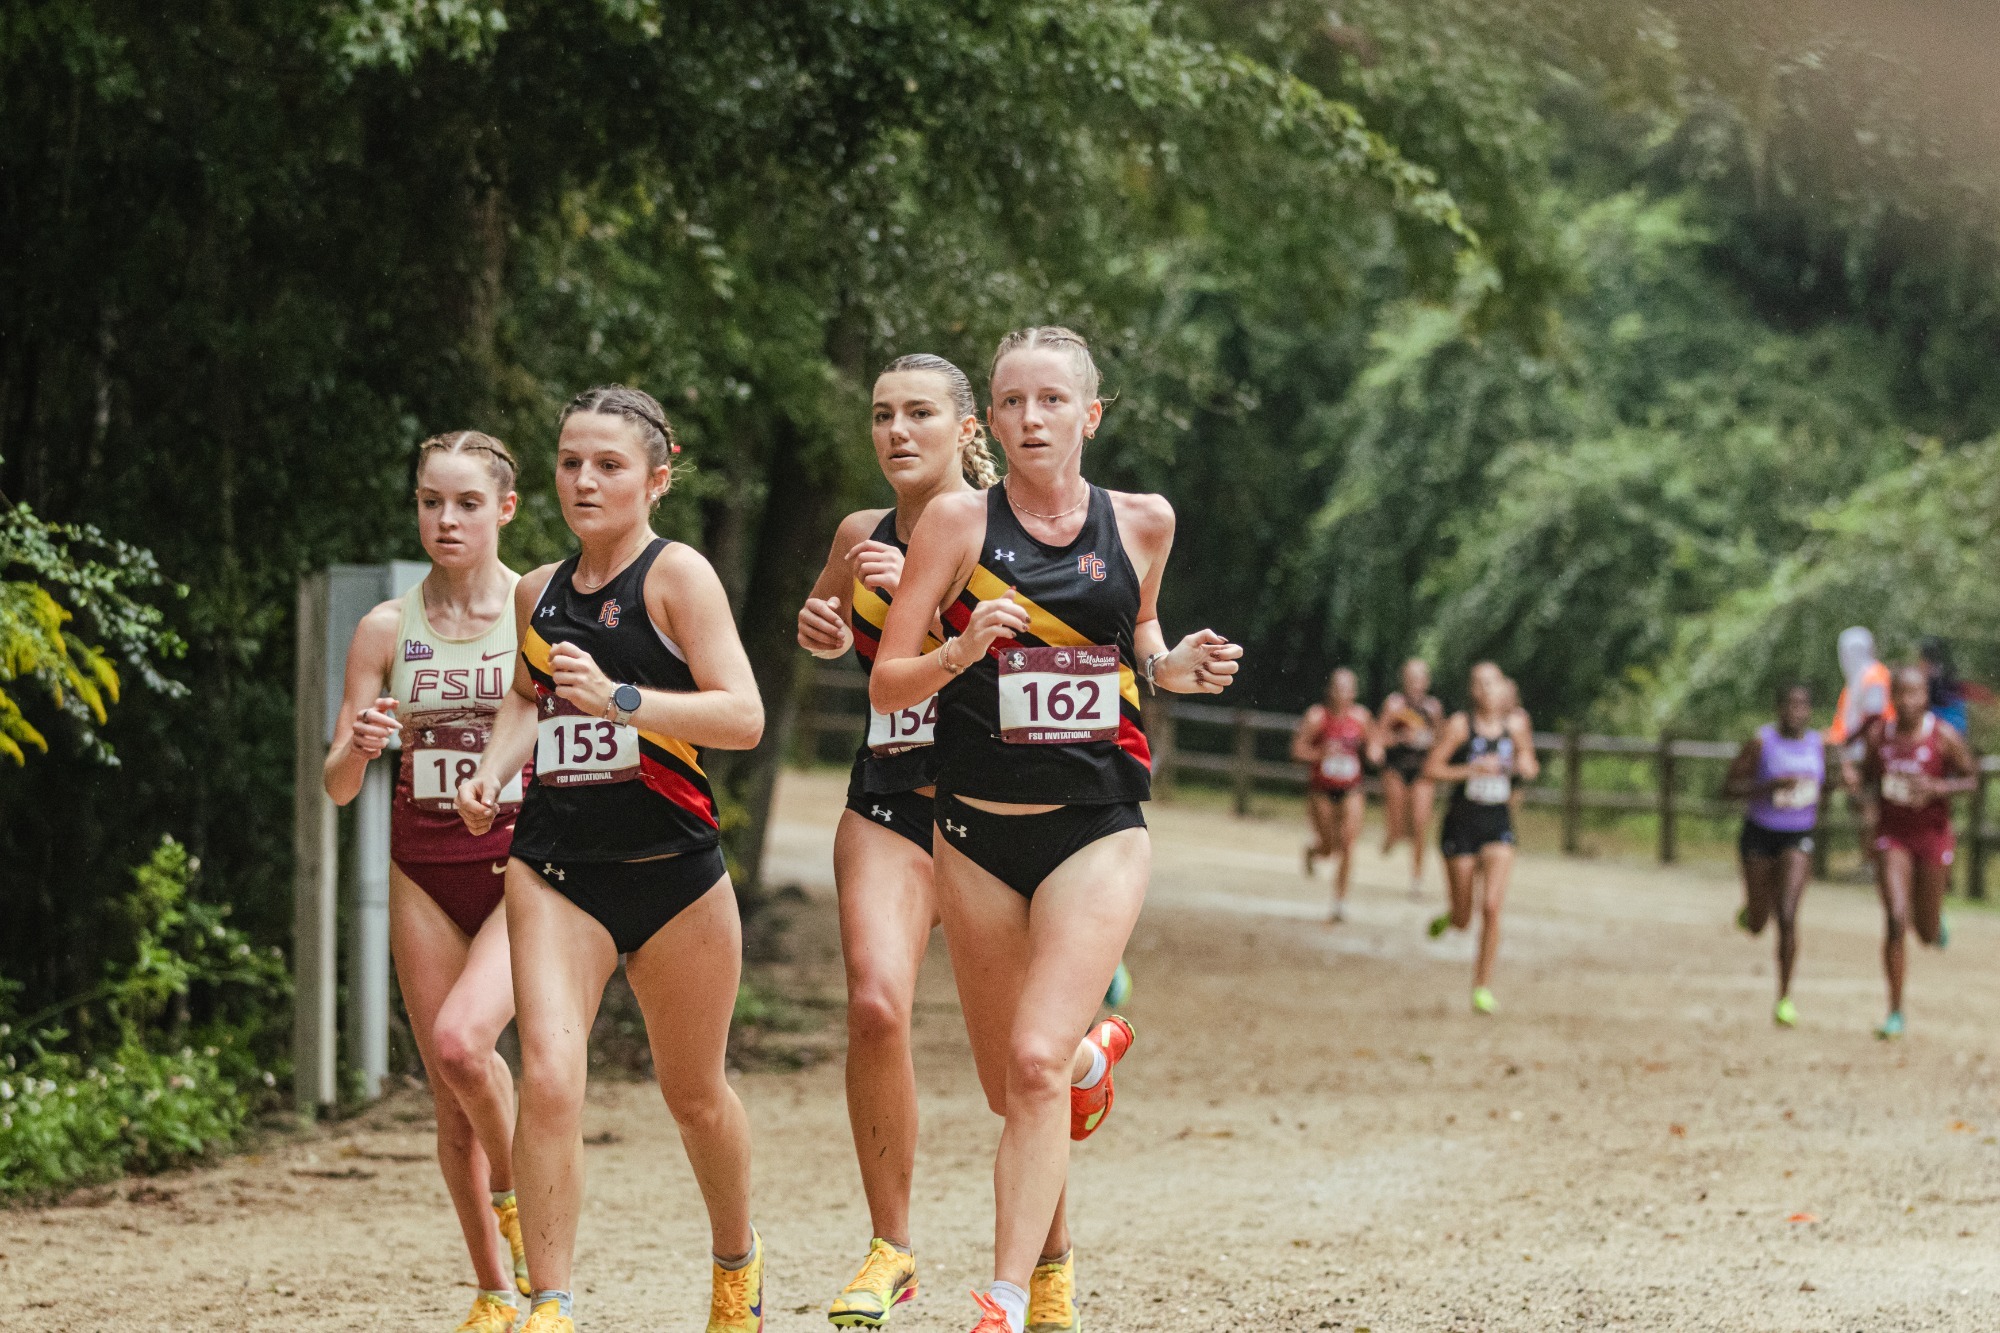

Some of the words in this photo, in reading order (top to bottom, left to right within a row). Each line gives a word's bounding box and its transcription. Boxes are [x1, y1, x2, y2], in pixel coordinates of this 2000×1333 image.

[1078, 552, 1106, 581] FC
[598, 599, 621, 628] FC
[409, 667, 504, 703] FSU
[1022, 680, 1101, 721] 162
[890, 695, 939, 738] 154
[554, 721, 618, 765] 153
[1028, 732, 1043, 740] FSU
[1045, 731, 1091, 740] INVITATIONAL
[433, 758, 478, 793] 18
[557, 775, 569, 784] FSU
[570, 772, 613, 782] INVITATIONAL
